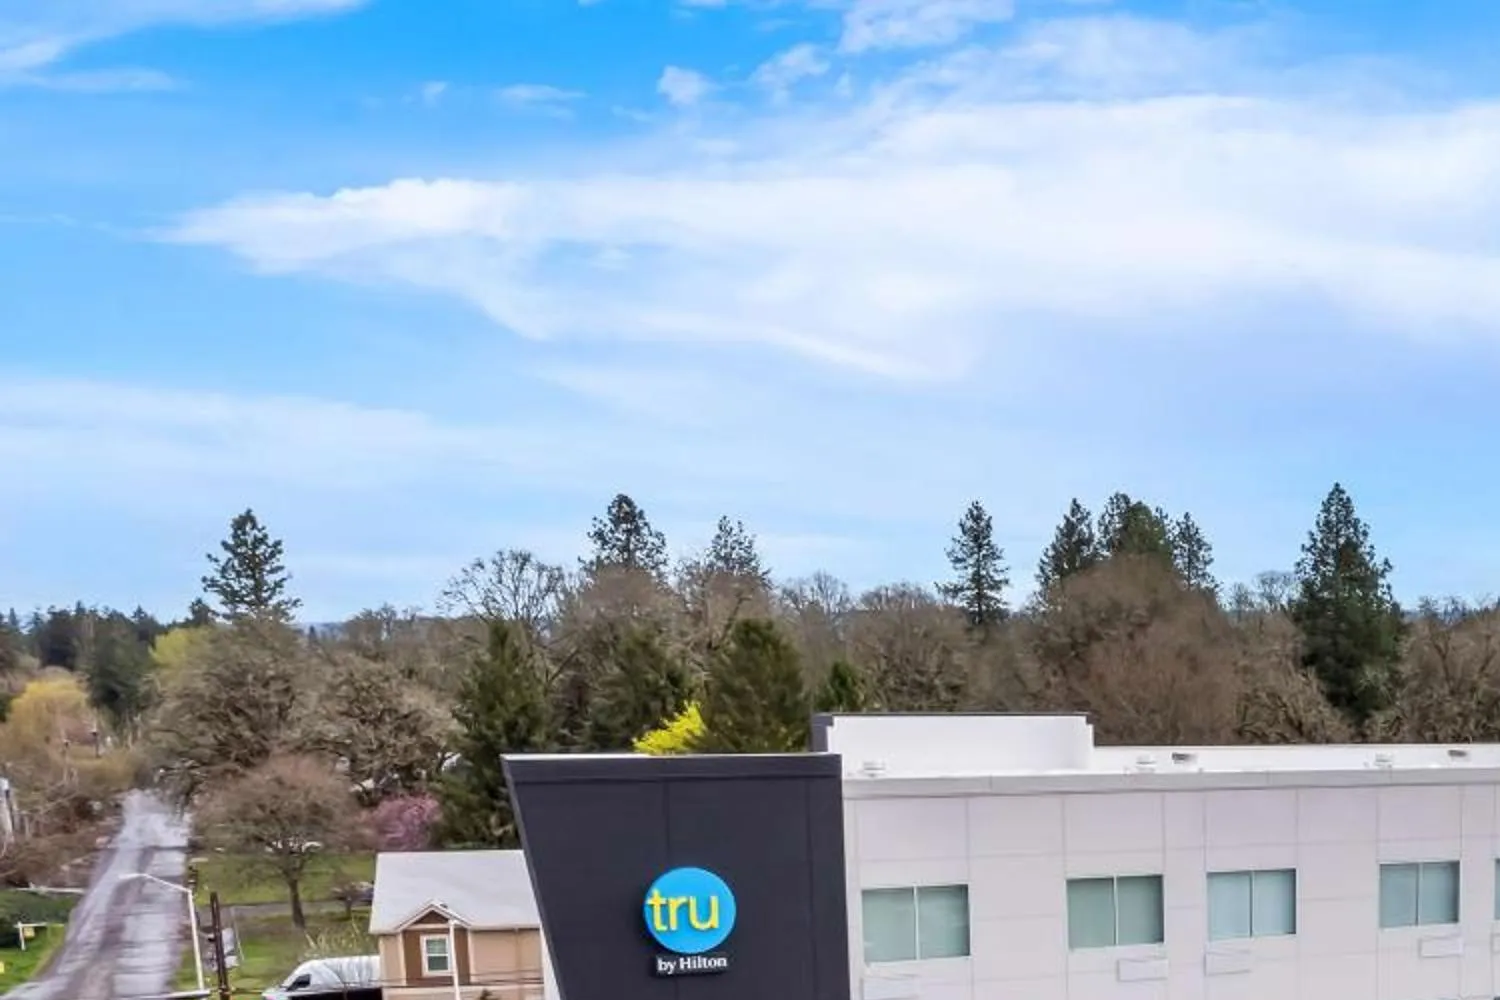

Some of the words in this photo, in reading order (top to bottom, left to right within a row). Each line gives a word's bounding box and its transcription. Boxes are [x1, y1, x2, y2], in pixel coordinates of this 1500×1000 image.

[647, 889, 719, 931] tru
[658, 958, 676, 974] by
[680, 956, 728, 969] Hilton
